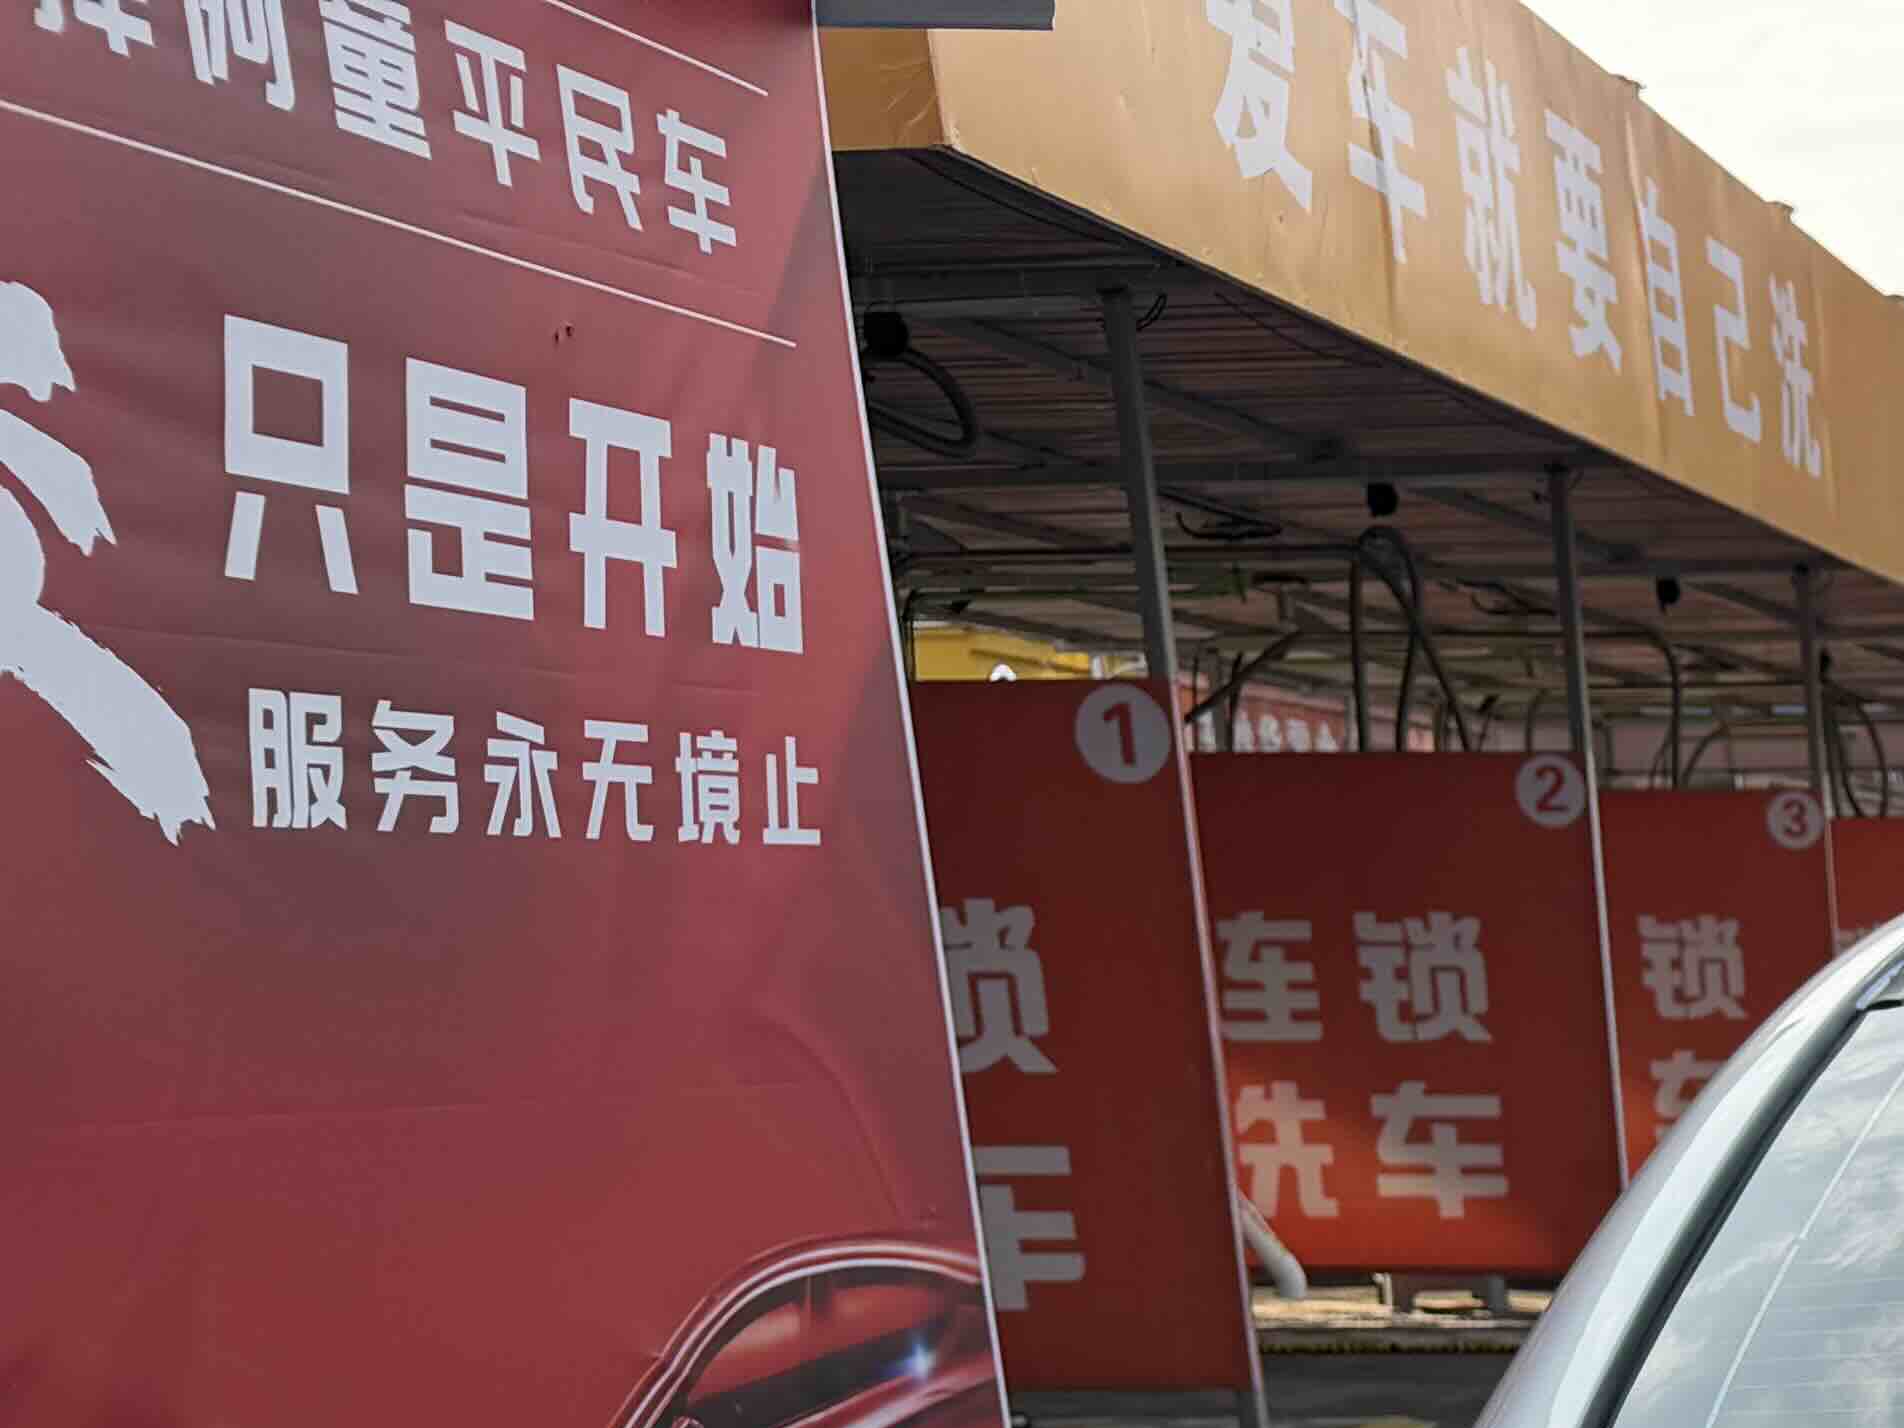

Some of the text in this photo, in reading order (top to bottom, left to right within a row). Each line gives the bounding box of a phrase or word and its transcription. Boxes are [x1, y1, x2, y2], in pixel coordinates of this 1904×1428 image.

[223, 314, 803, 654] 只是开始
[247, 687, 822, 846] 服务永无境止
[1100, 702, 1140, 769] 1
[1533, 763, 1568, 813] 2
